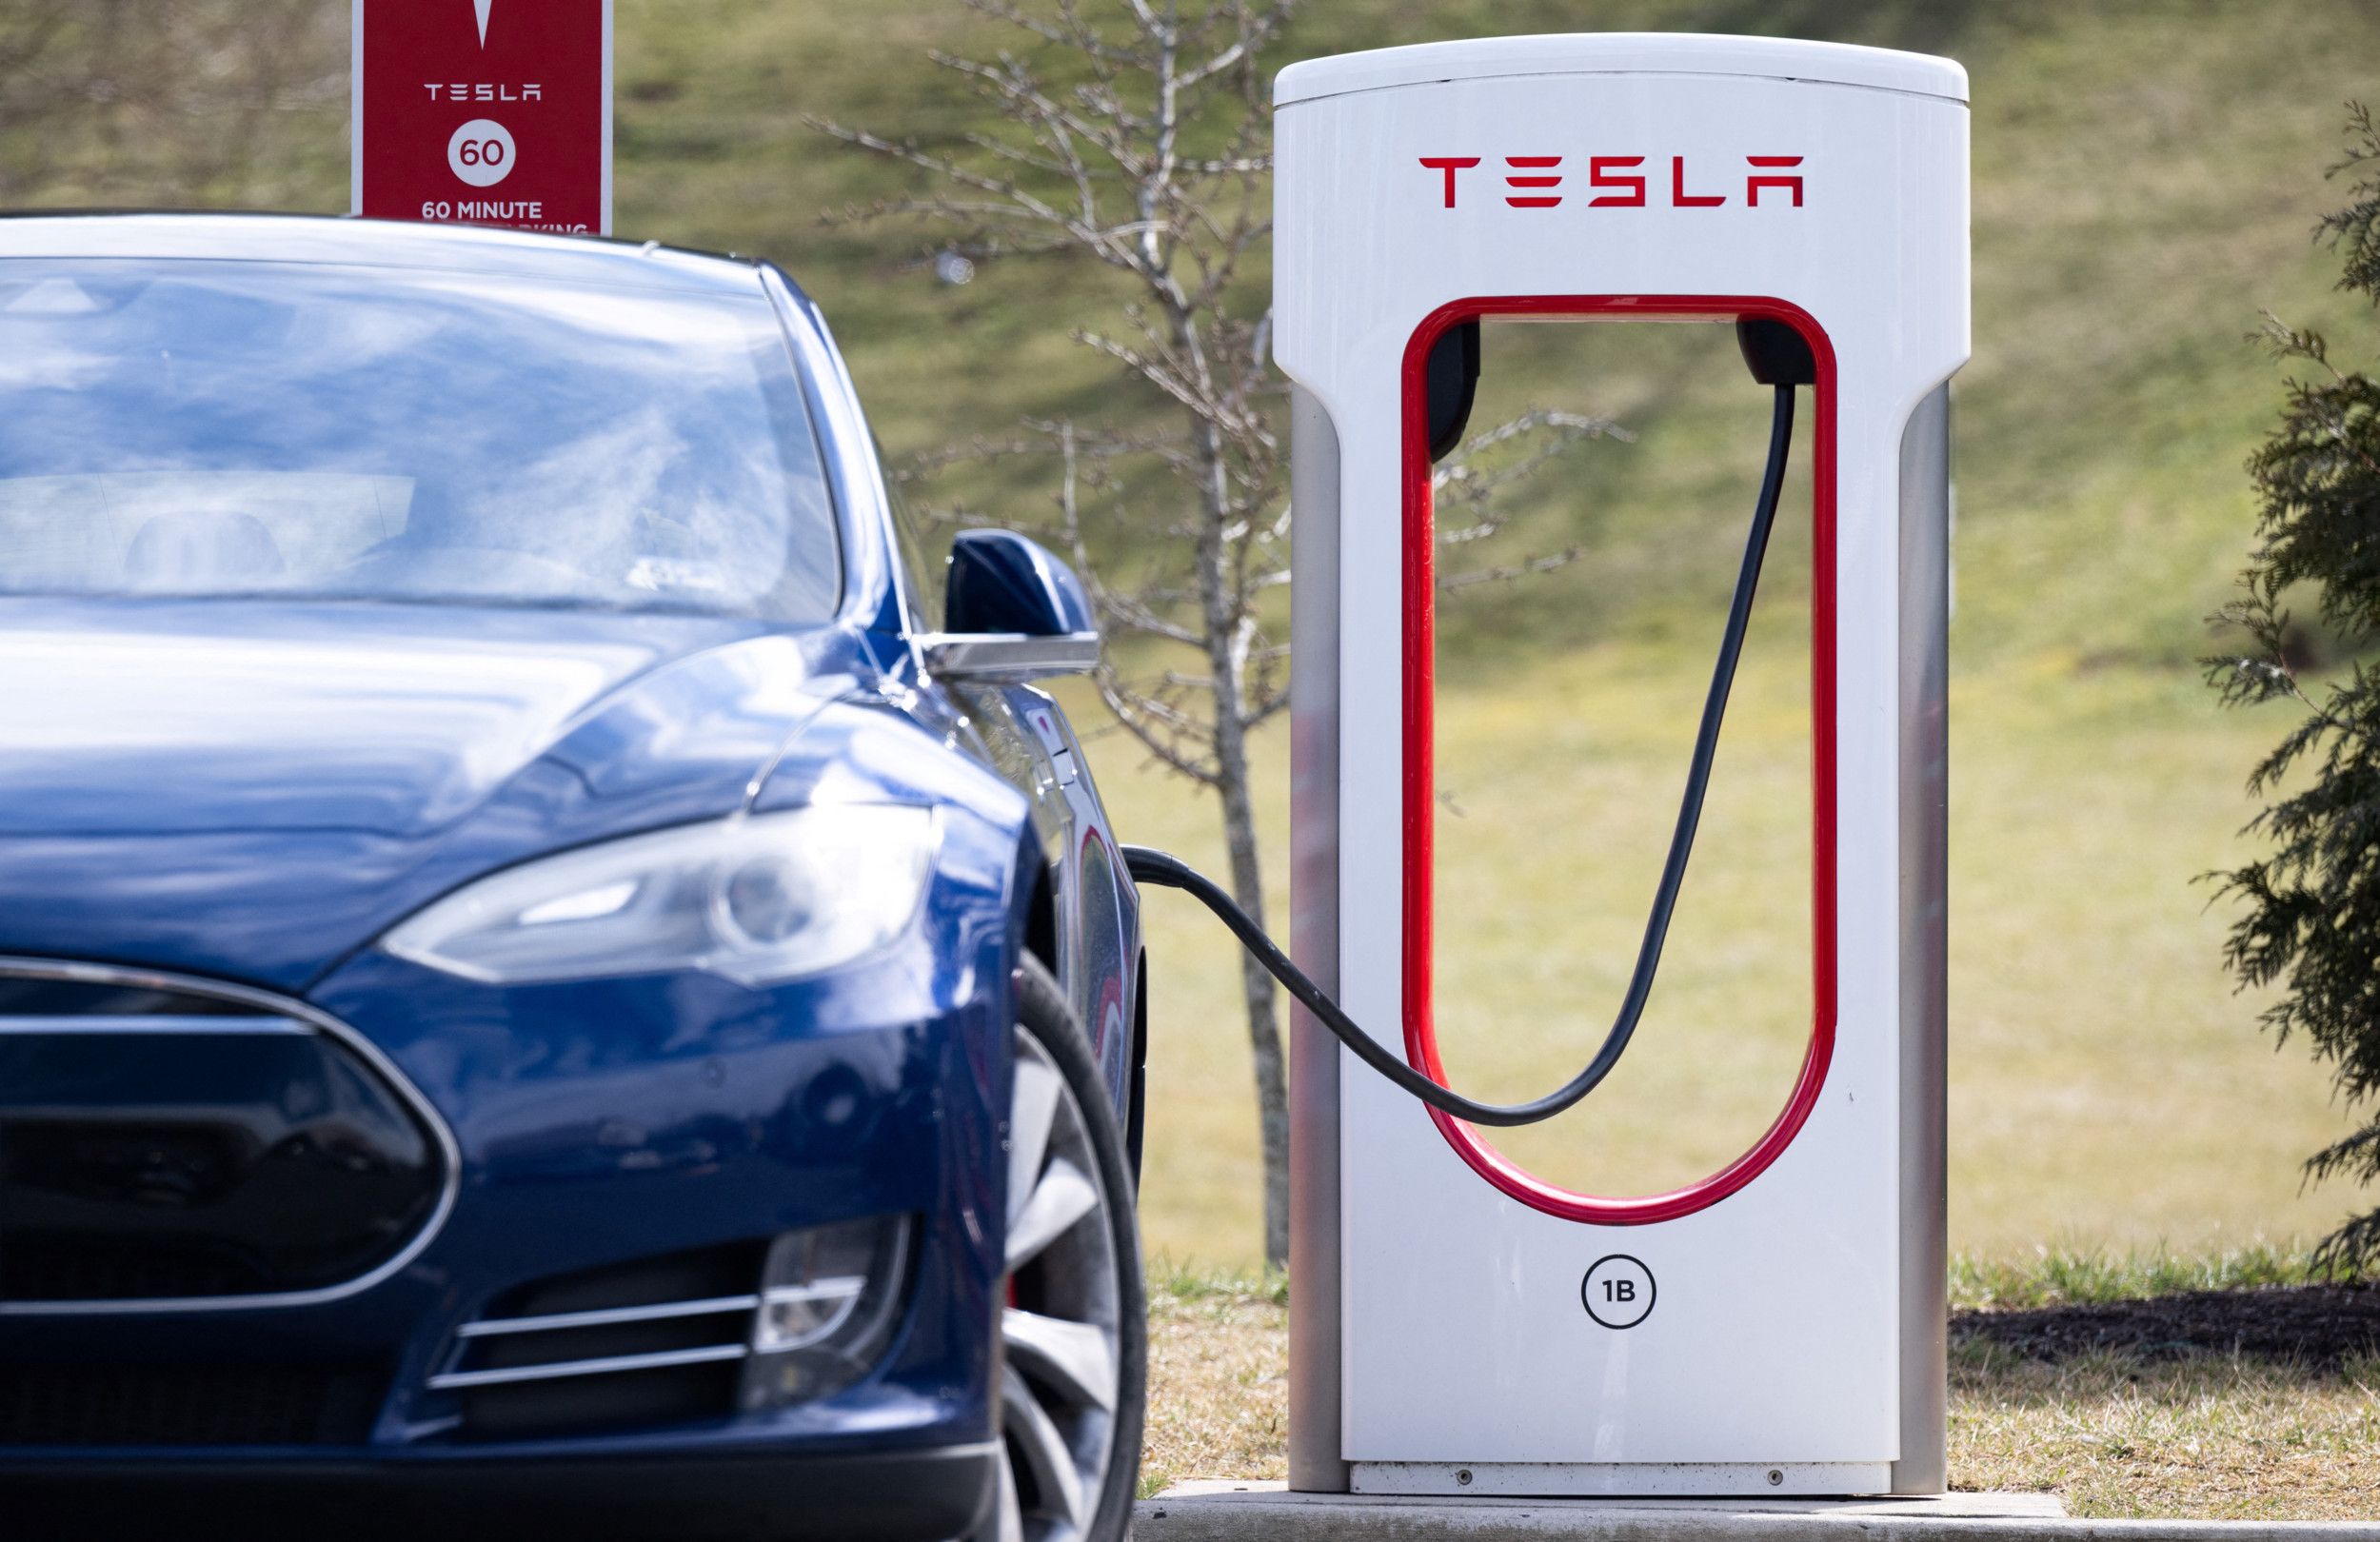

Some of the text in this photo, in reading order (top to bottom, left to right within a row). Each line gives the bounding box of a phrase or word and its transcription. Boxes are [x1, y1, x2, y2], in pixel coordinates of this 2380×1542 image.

[424, 84, 541, 101] TESLA
[459, 139, 505, 166] 60
[1418, 156, 1804, 208] TESLA
[422, 202, 543, 219] 60 MINUTE
[1602, 1279, 1636, 1302] 1B
